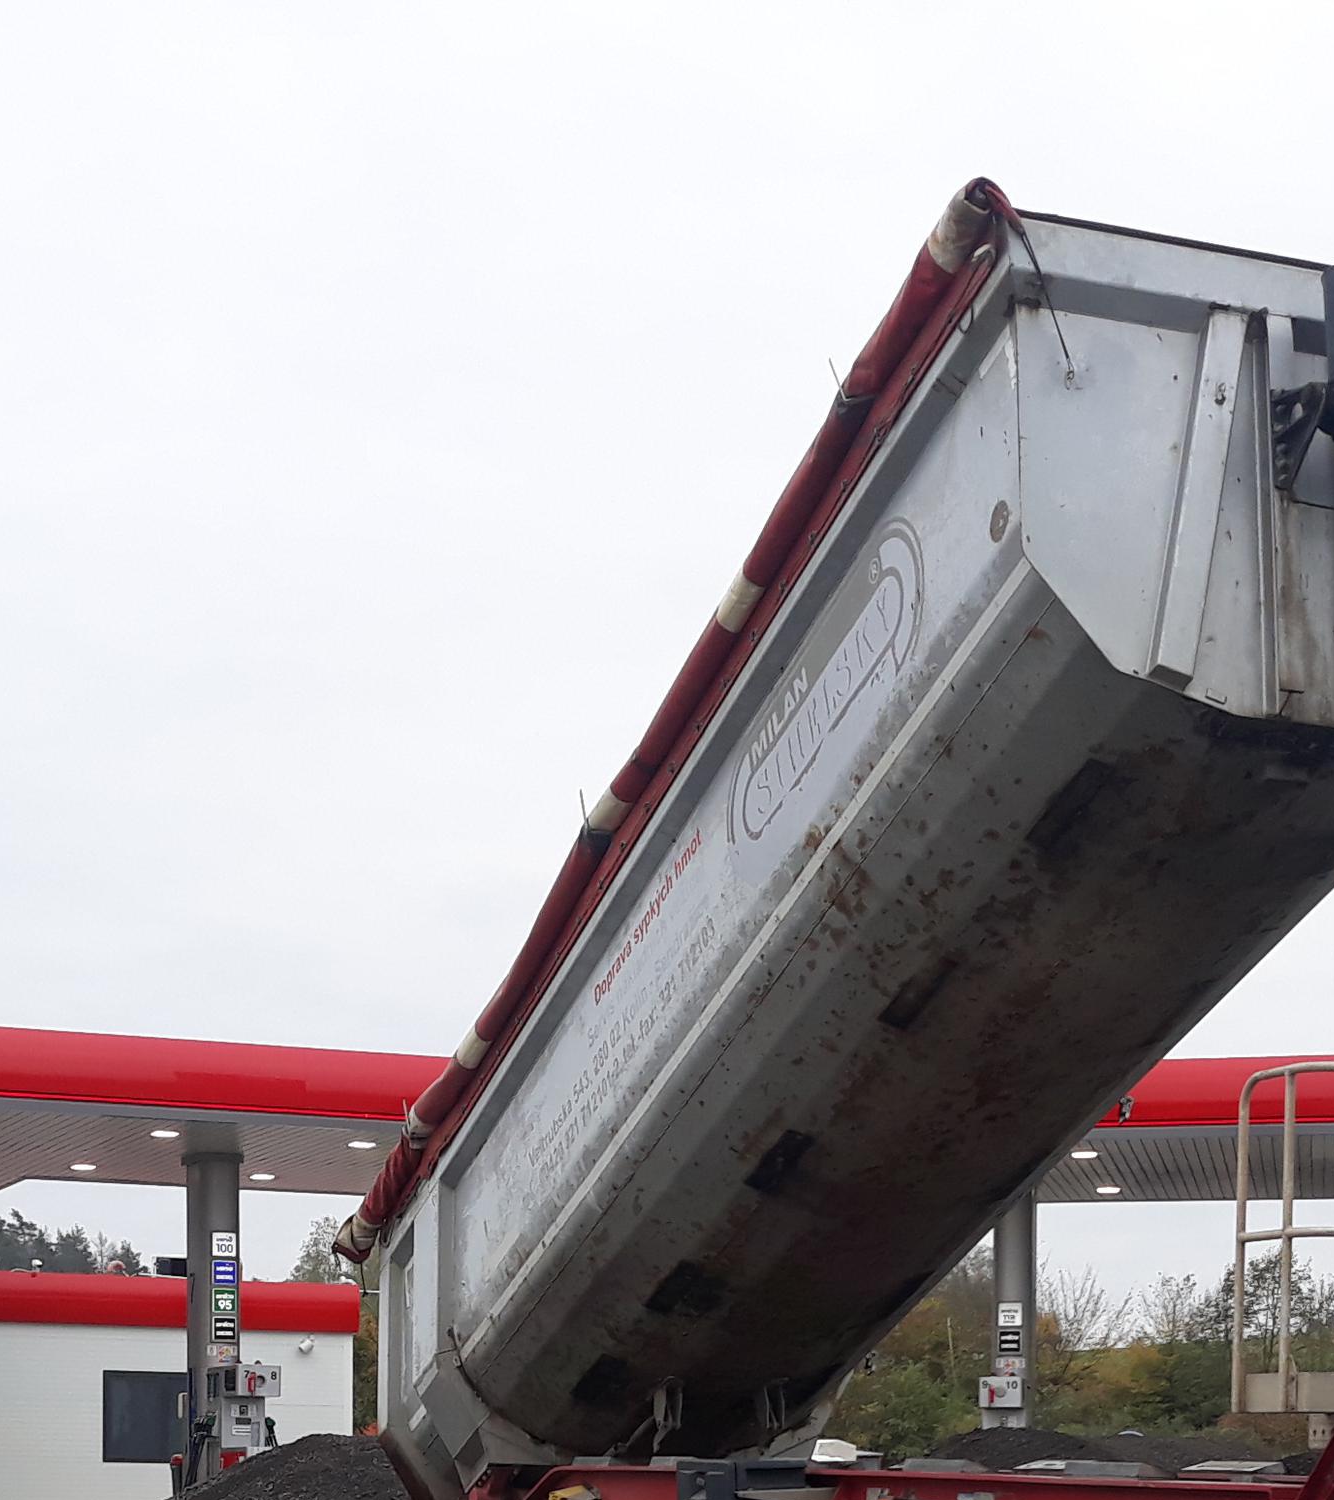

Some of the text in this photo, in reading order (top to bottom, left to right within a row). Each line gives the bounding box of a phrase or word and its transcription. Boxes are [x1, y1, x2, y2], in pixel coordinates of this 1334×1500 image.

[749, 667, 809, 769] MILAN
[594, 940, 632, 1006] Doprava
[633, 875, 673, 945] sypkých
[674, 827, 703, 877] hmot
[216, 1243, 234, 1254] 100
[218, 1299, 233, 1310] 95
[244, 1370, 250, 1379] 7
[270, 1371, 278, 1381] 8
[981, 1380, 988, 1389] 9
[1006, 1380, 1018, 1389] 10
